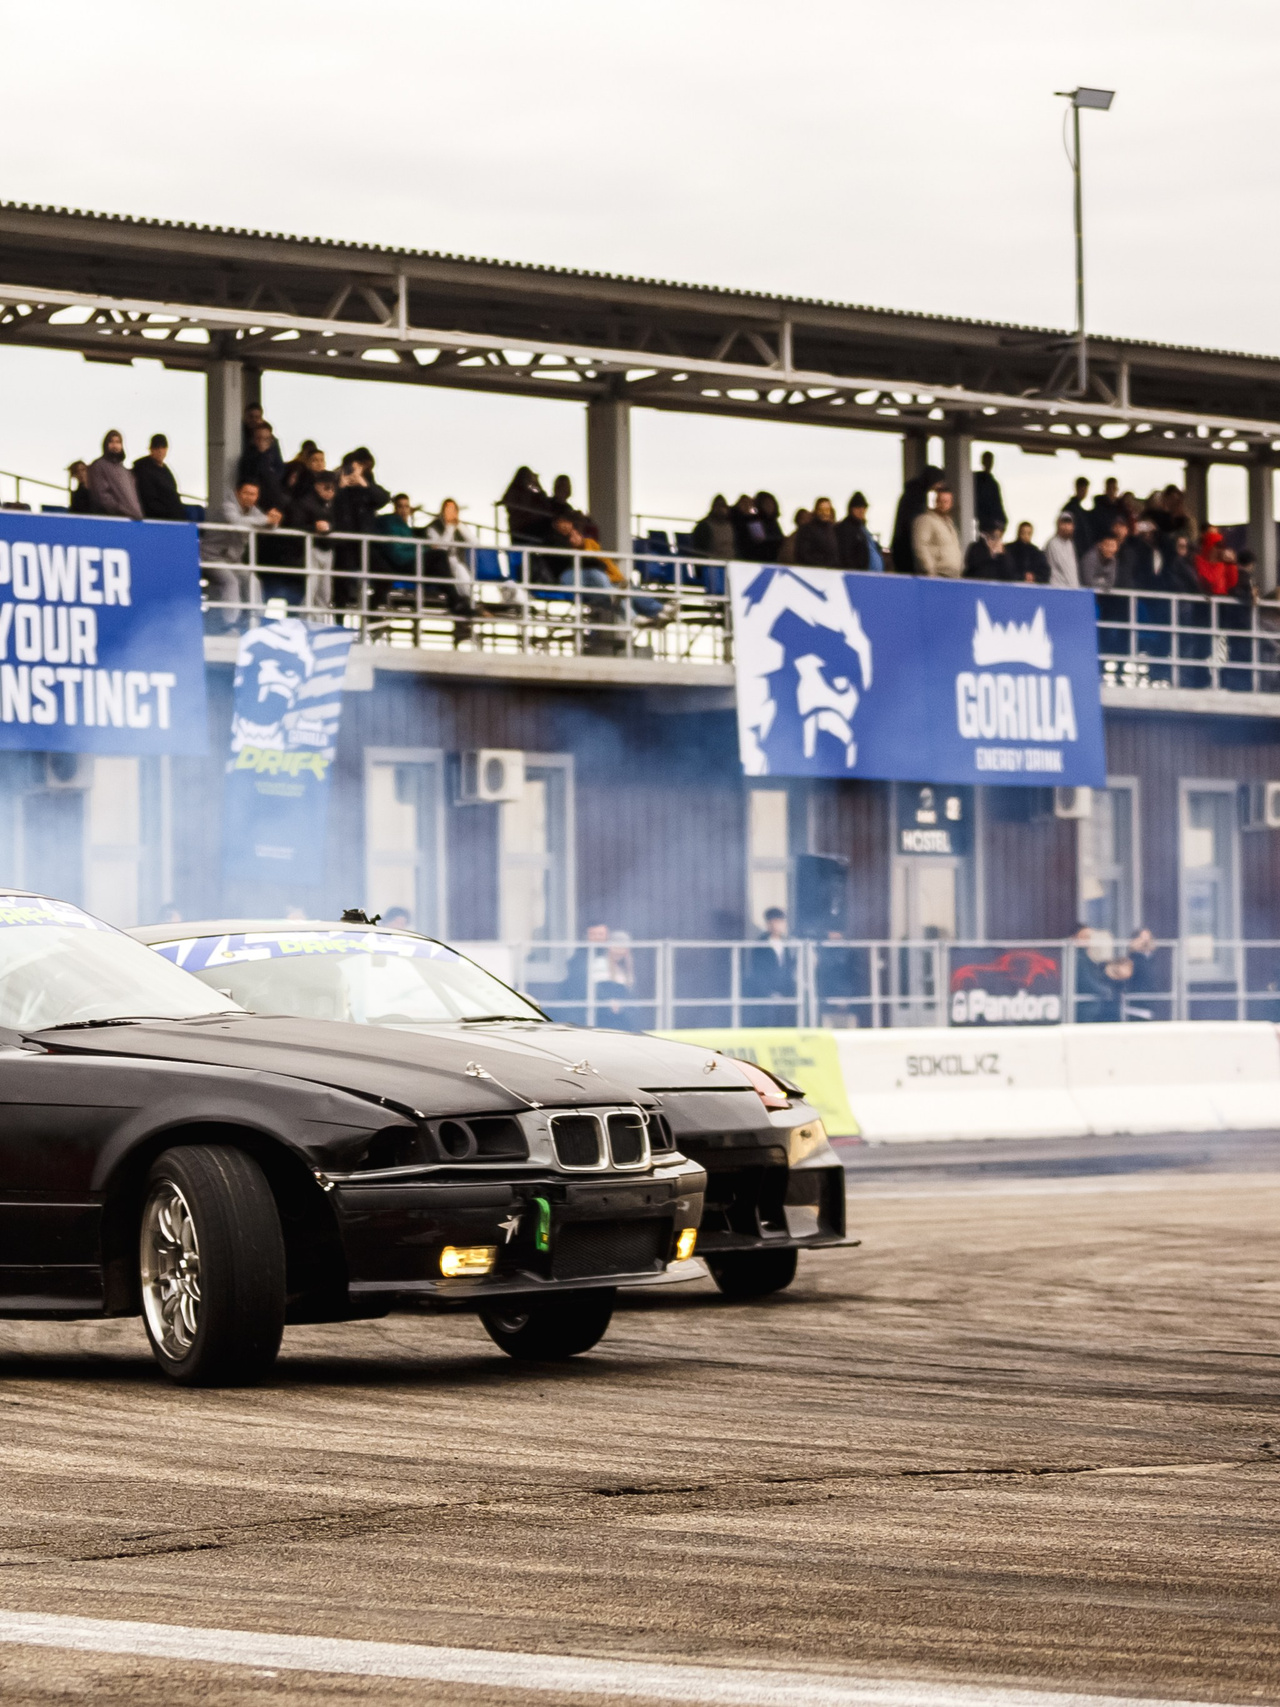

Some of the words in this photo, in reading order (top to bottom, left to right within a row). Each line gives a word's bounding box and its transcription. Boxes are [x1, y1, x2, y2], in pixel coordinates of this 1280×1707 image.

[956, 672, 1077, 741] GORILLA
[235, 744, 329, 781] DRIFT
[975, 747, 1022, 771] ENERGY
[1025, 748, 1063, 772] DRINK
[901, 829, 951, 853] HOSTEL
[968, 988, 1060, 1022] Pandora
[906, 1053, 1001, 1077] SOKOL.KZ
